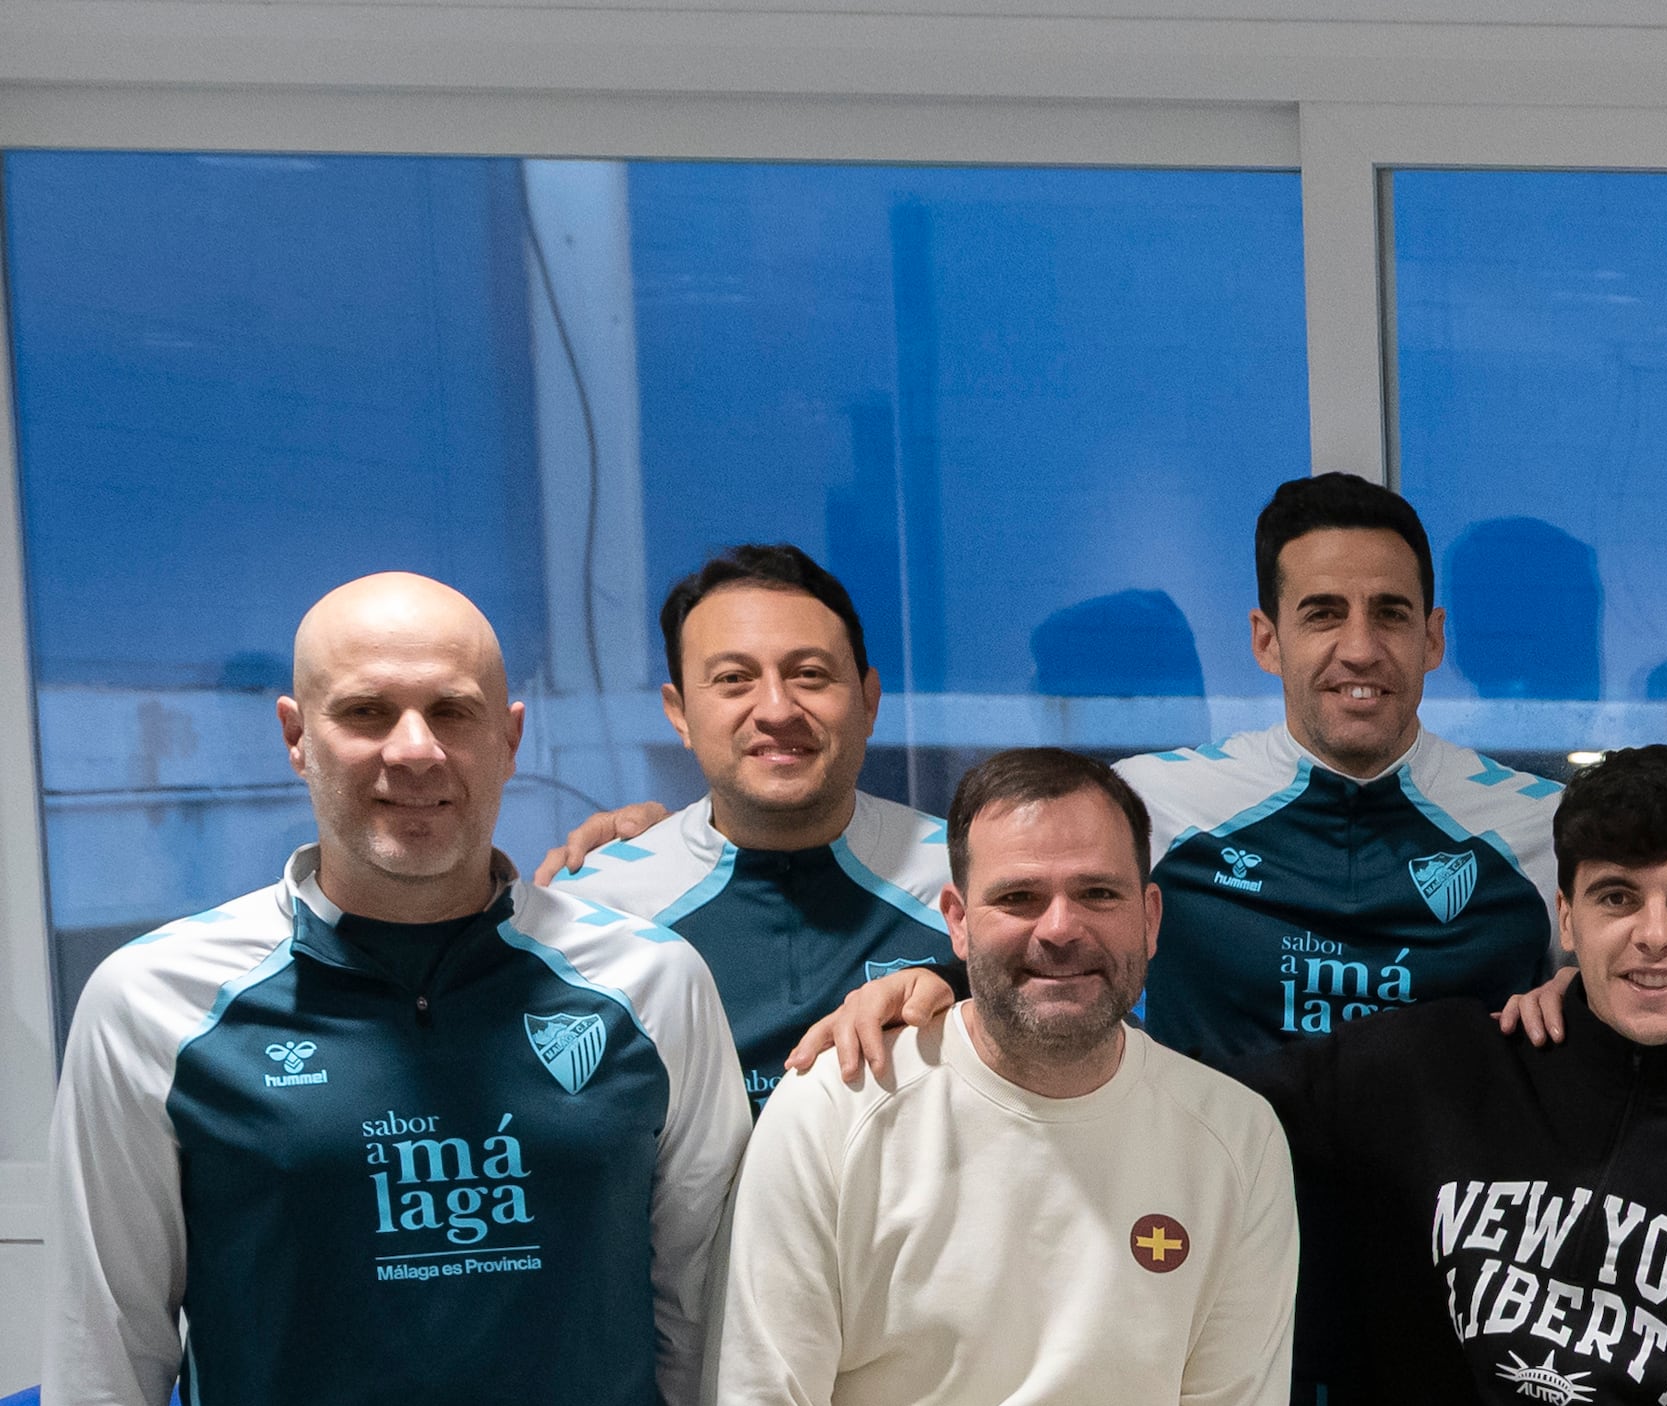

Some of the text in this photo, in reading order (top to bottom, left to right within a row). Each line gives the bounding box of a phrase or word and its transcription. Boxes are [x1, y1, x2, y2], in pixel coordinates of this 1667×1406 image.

[1214, 869, 1262, 893] hummel
[1281, 931, 1344, 955] sabor
[1280, 949, 1417, 1002] a má
[265, 1069, 328, 1088] hummel
[362, 1110, 439, 1137] sabor
[367, 1112, 532, 1185] a má
[373, 1172, 535, 1245] laga
[1432, 1180, 1593, 1268] NEW
[377, 1255, 542, 1281] Málaga es Provincia
